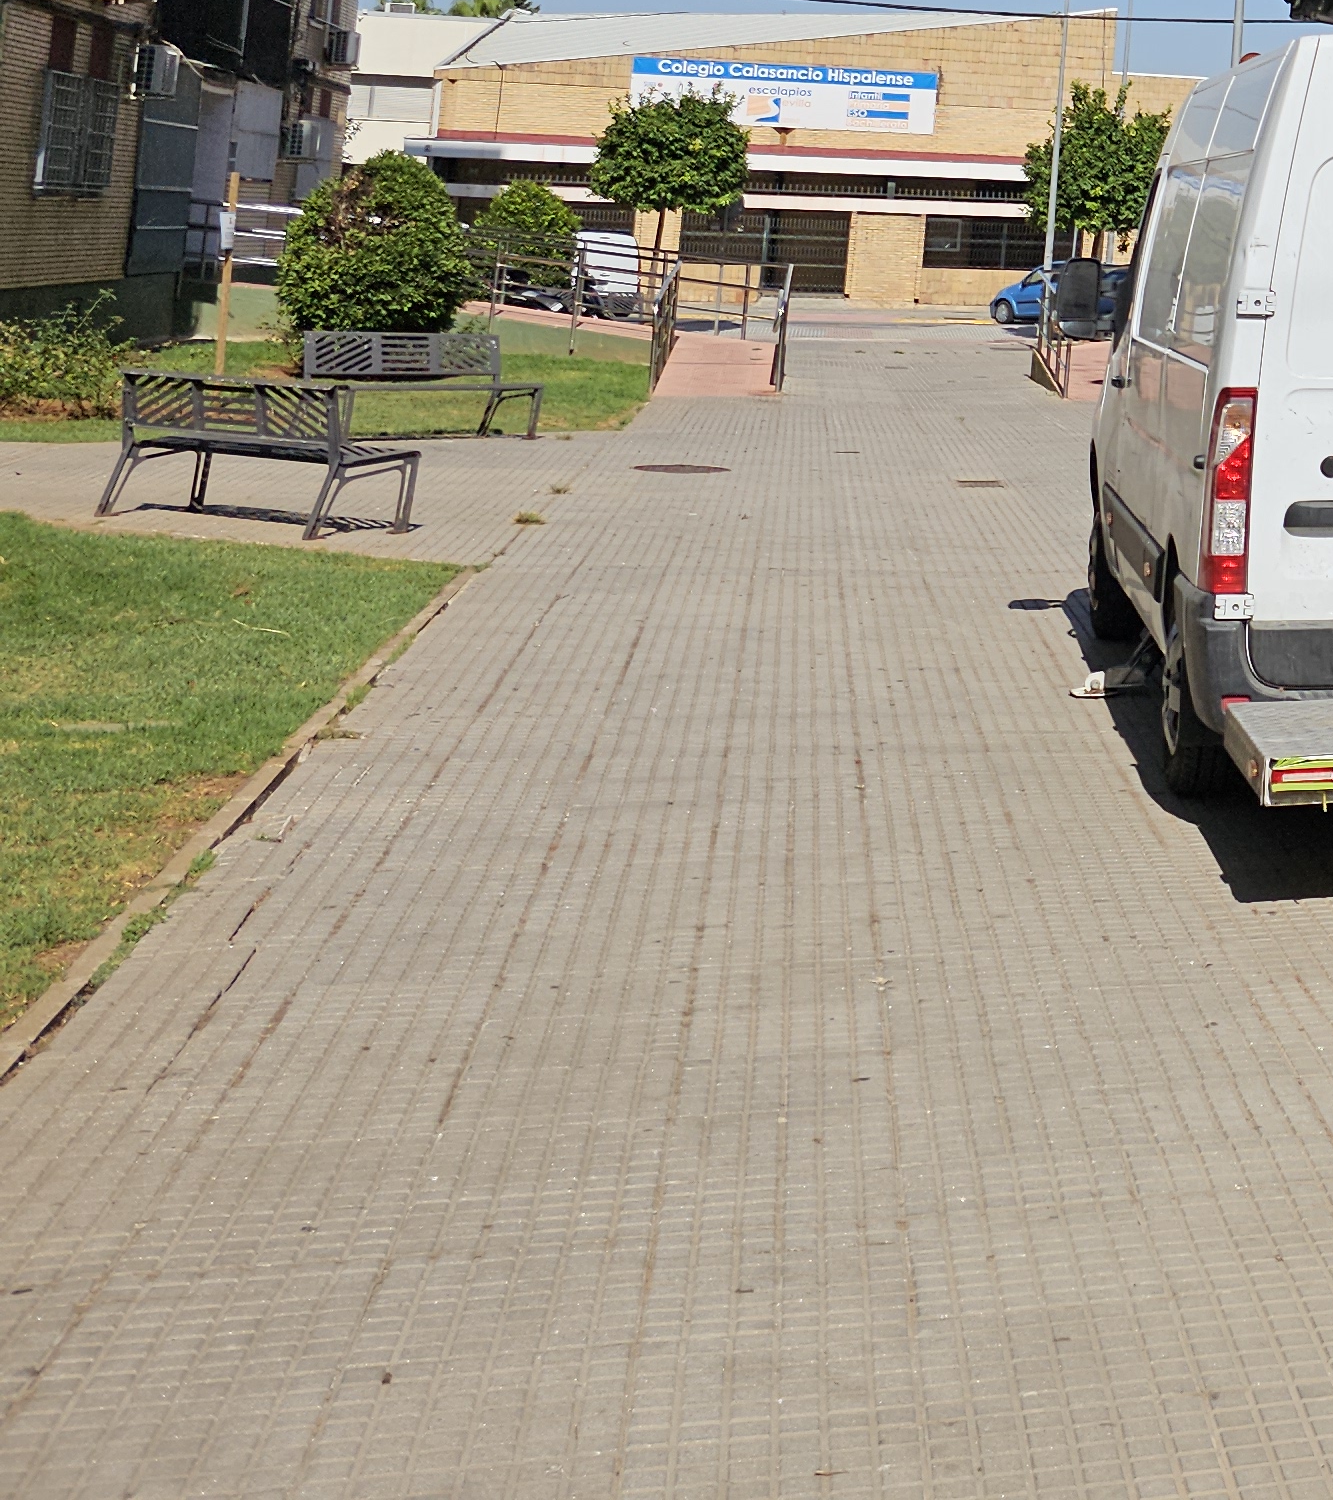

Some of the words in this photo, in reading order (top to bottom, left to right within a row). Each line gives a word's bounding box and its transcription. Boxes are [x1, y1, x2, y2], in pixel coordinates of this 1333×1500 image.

[658, 59, 725, 78] Colegio
[729, 63, 823, 81] Calasancio
[828, 69, 914, 86] Hispalense
[748, 85, 812, 98] escolapios
[847, 108, 868, 118] ESO
